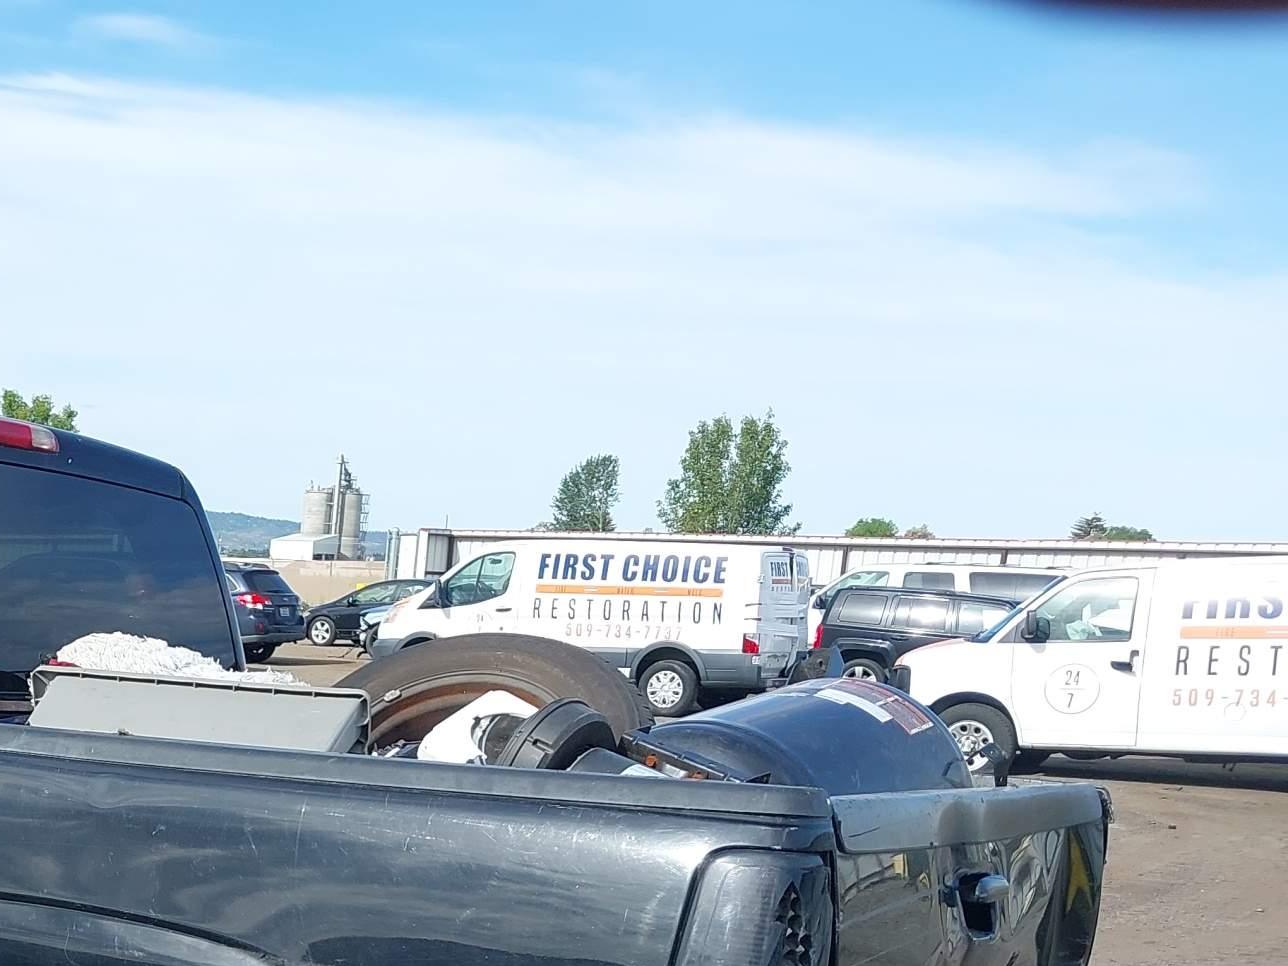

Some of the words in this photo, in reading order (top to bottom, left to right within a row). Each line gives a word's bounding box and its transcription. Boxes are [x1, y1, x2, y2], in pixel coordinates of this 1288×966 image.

[538, 553, 614, 581] FIRST
[622, 554, 728, 583] CHOICE
[533, 598, 723, 624] RESTORATION
[565, 623, 682, 641] 509-734-7737
[1065, 670, 1080, 685] 24
[1067, 693, 1074, 708] 7
